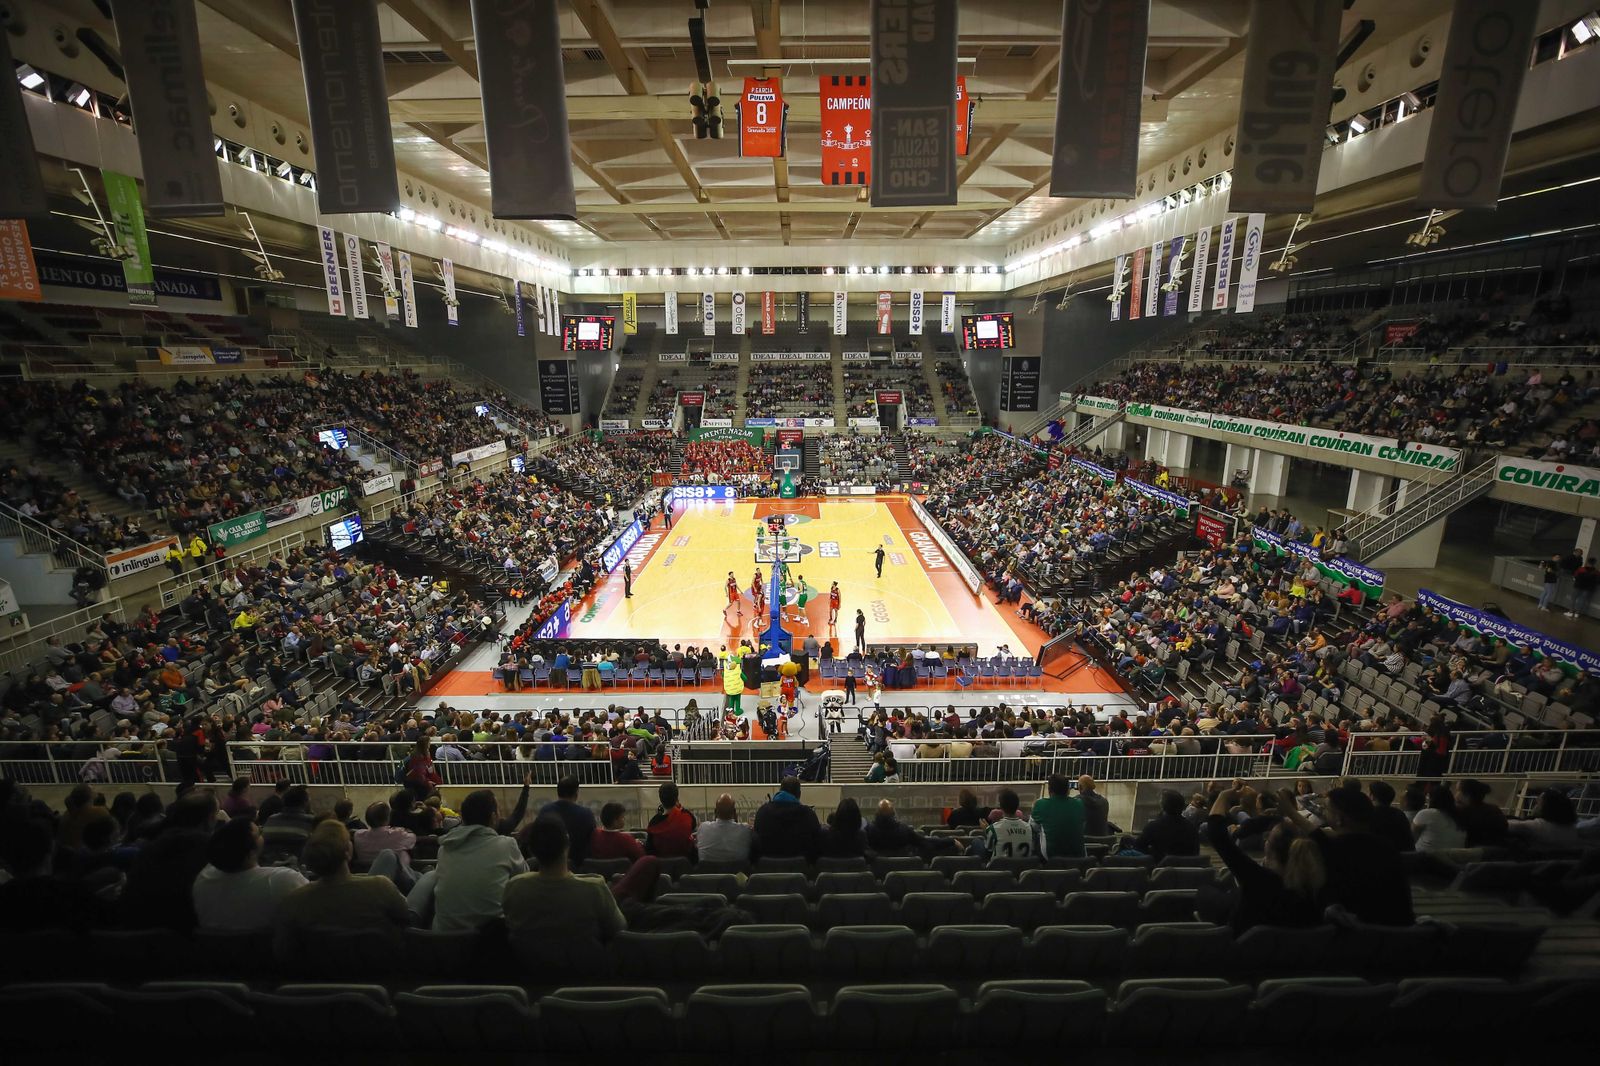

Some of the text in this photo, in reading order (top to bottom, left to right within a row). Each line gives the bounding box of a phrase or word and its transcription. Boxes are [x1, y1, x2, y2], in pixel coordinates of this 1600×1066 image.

[756, 103, 767, 125] 8
[826, 97, 871, 111] CAMPEÓN
[321, 230, 340, 297] BERNER
[1218, 222, 1234, 290] BERNER
[101, 271, 123, 288] DE
[154, 277, 198, 297] ANADA
[912, 292, 922, 323] asisa
[735, 306, 744, 334] otero
[644, 419, 663, 427] asisa
[1153, 410, 1186, 423] COVIRAN
[1211, 418, 1306, 444] COVIRAN COVIRAN
[1309, 433, 1457, 472] COVIRAN COVIRAN
[323, 489, 346, 510] CSIF
[909, 531, 950, 569] GRANADA
[120, 553, 162, 574] inlingua
[1344, 562, 1362, 575] PULEVA
[1362, 570, 1384, 583] PULEVA
[13, 617, 21, 626] A
[1427, 596, 1451, 611] PULEVA
[1451, 607, 1478, 622] PULEVA
[1479, 617, 1508, 634] PULEVA
[1508, 628, 1541, 645] PULEVA
[1543, 640, 1577, 658] PULEVA
[1007, 827, 1027, 836] JAVIER
